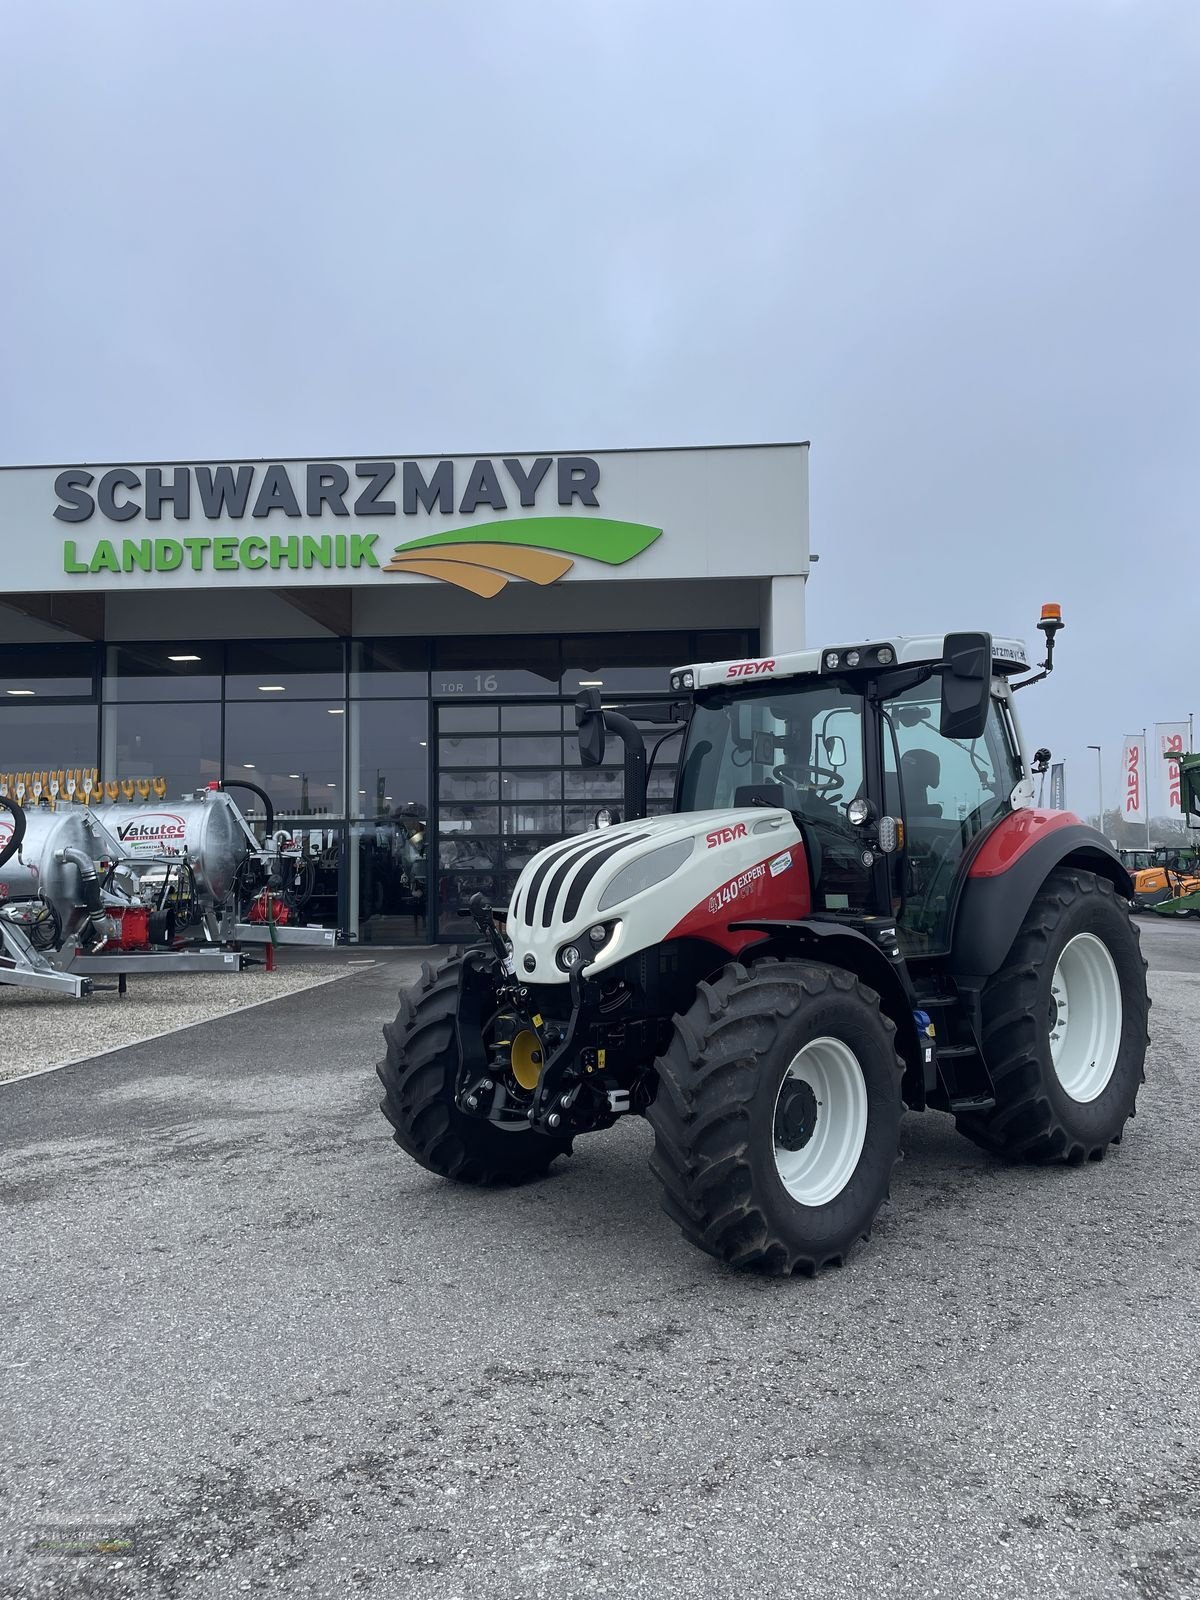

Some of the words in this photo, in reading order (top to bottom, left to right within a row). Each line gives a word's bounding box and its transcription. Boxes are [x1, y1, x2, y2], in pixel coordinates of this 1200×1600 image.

[53, 456, 601, 524] SCHWARZMAYR
[64, 534, 381, 574] LANDTECHNIK
[726, 660, 776, 678] STEYR
[441, 683, 464, 693] TOR
[474, 675, 498, 692] 16
[116, 821, 185, 841] Vakutec
[706, 823, 747, 848] STEYR
[708, 881, 738, 913] 4140
[738, 864, 766, 888] EXPERT
